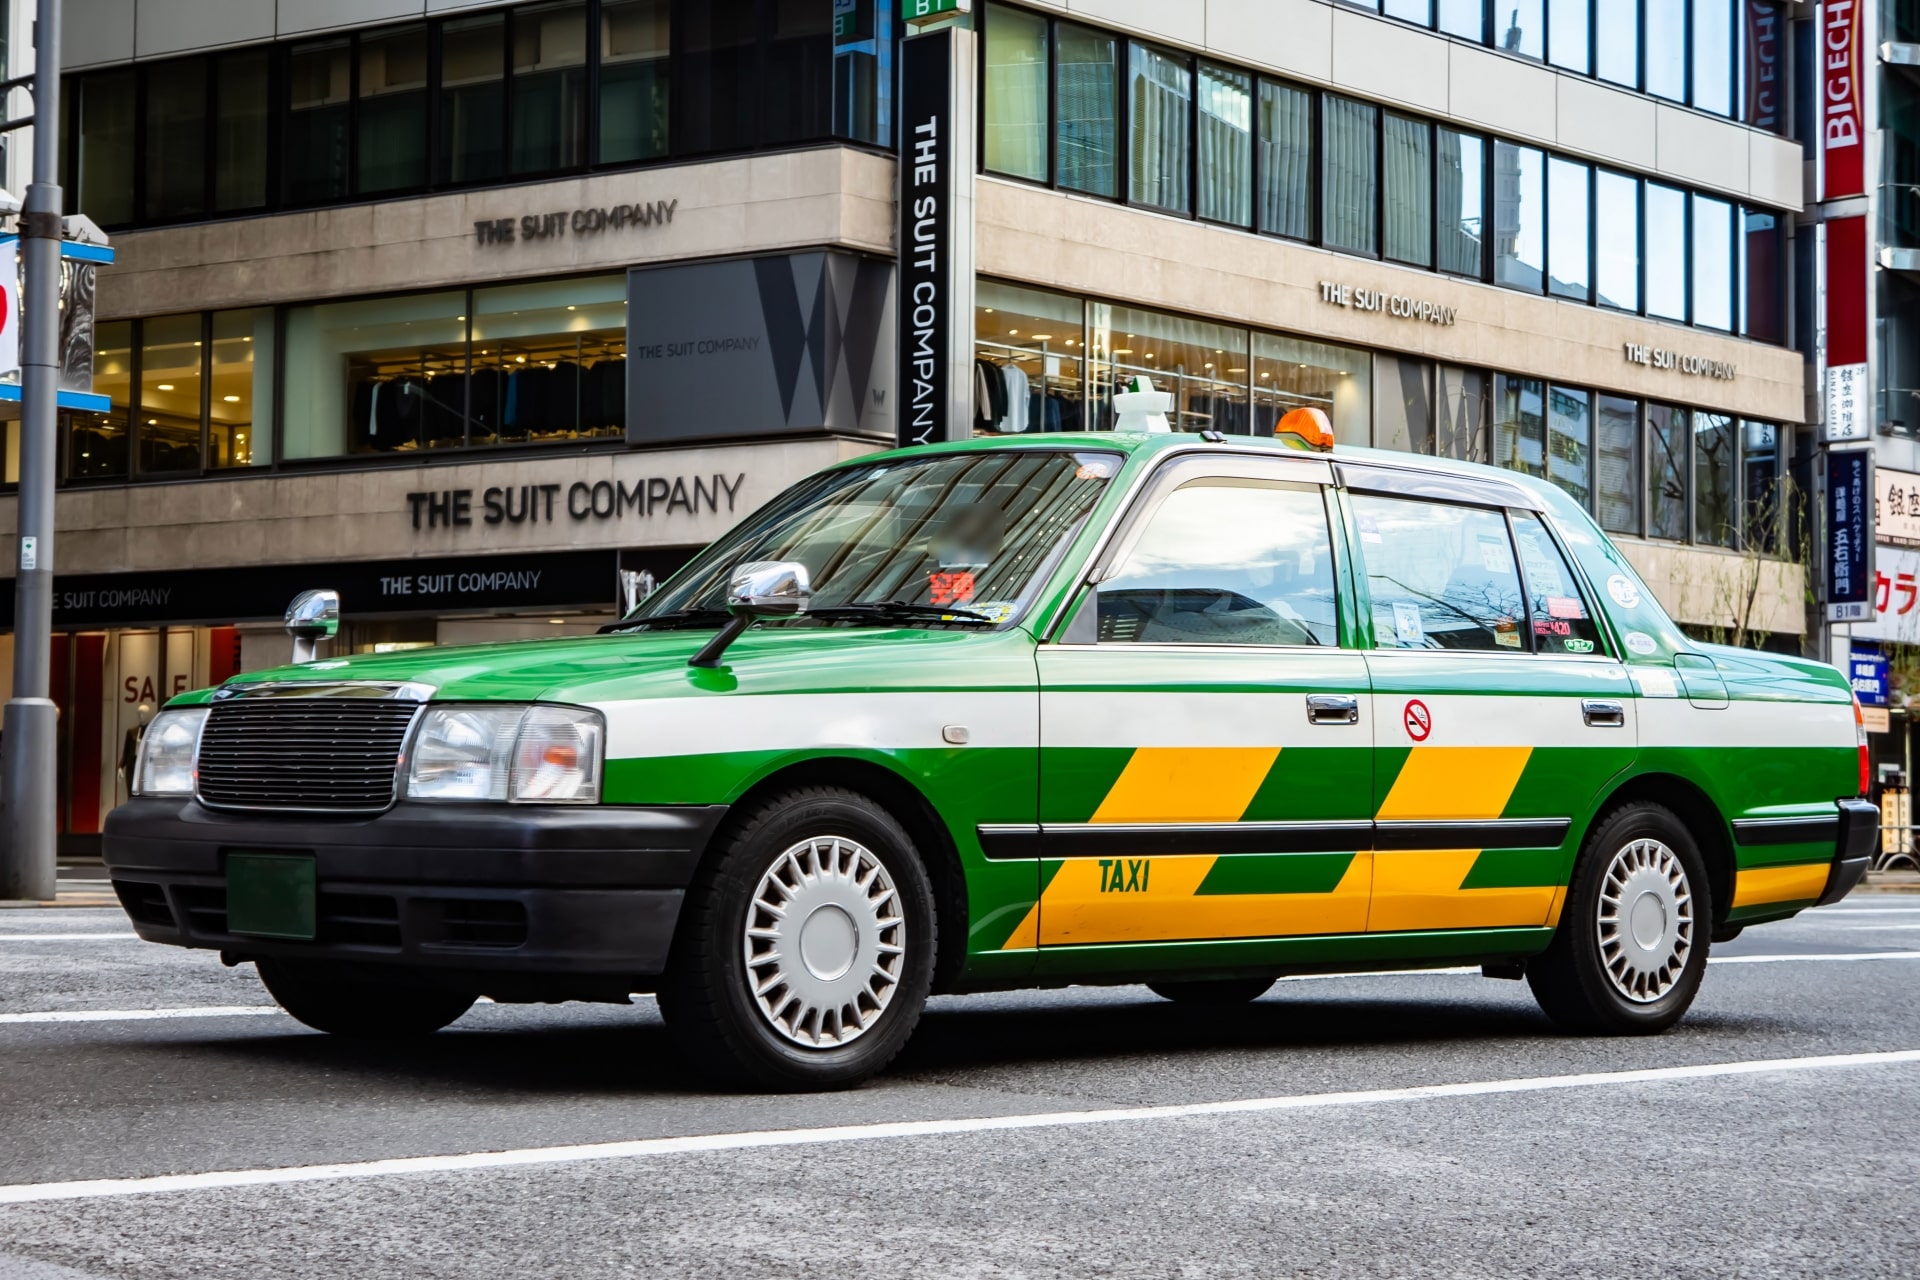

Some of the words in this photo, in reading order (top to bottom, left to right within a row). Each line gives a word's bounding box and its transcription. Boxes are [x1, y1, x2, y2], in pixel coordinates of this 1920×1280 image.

[1826, 76, 1859, 149] BIG
[914, 115, 937, 187] THE
[474, 218, 516, 245] THE
[521, 212, 569, 240] SUIT
[571, 198, 678, 234] COMPANY
[914, 196, 936, 272] SUIT
[1319, 280, 1351, 307] THE
[1352, 287, 1388, 313] SUIT
[1389, 294, 1458, 326] COMPANY
[638, 345, 663, 360] THE
[667, 342, 695, 356] SUIT
[697, 336, 760, 354] COMPANY
[912, 281, 936, 445] COMPANY
[1624, 342, 1651, 366] THE
[1652, 348, 1677, 370] SUIT
[1680, 354, 1736, 381] COMPANY
[407, 489, 472, 529] THE
[483, 484, 560, 524] SUIT
[567, 473, 745, 520] COMPANY
[63, 590, 97, 609] SUIT
[99, 587, 171, 607] COMPANY
[380, 576, 412, 595] THE
[417, 574, 455, 593] SUIT
[457, 570, 542, 592] COMPANY
[124, 674, 188, 703] SAE
[1098, 859, 1150, 892] TAXI
